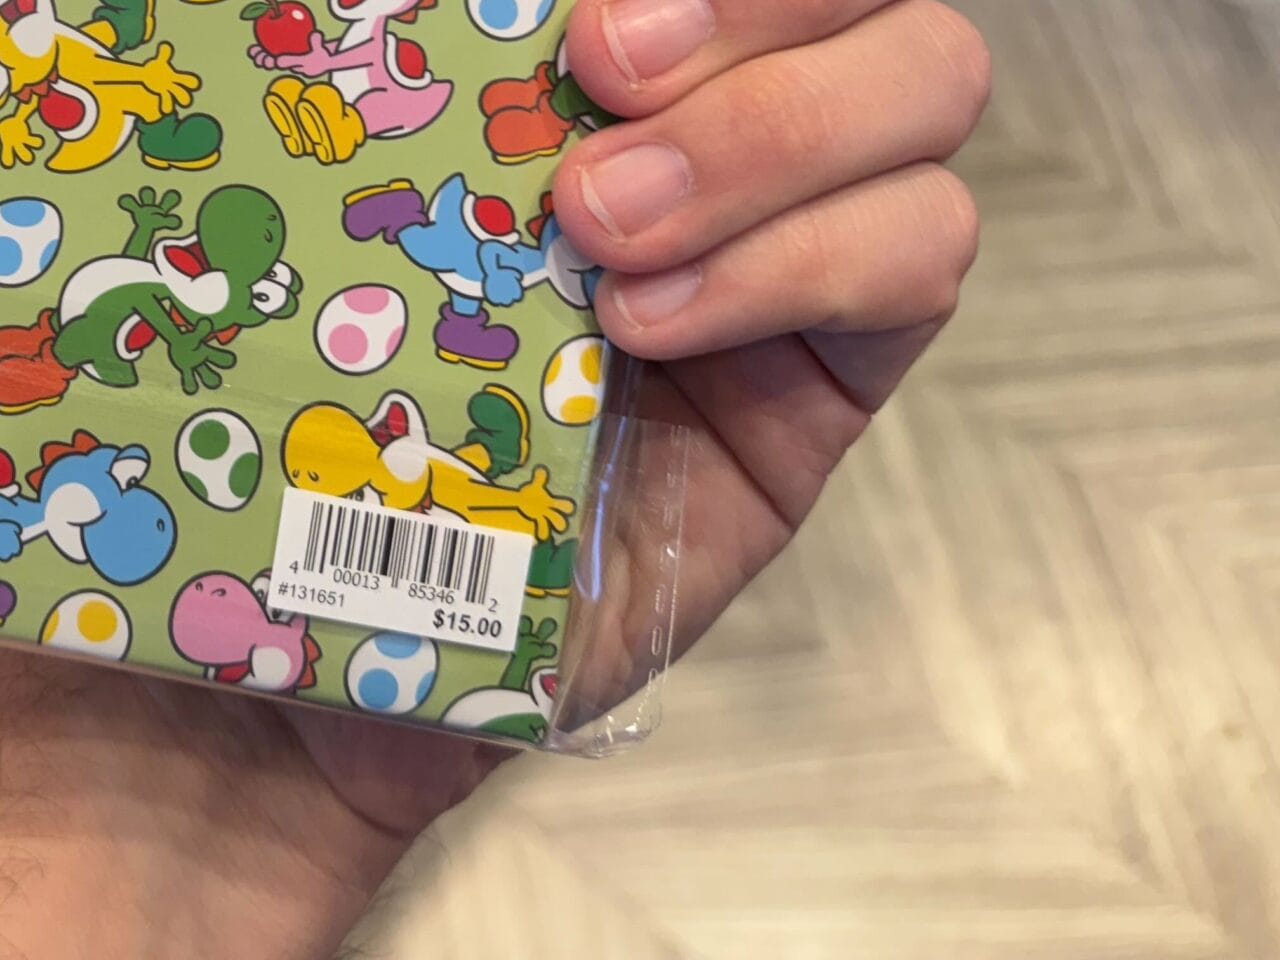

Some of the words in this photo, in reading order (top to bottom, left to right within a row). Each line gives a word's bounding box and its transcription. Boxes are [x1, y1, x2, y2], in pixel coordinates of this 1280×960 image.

[278, 582, 345, 607] #131651
[289, 560, 299, 574] 4
[333, 568, 380, 590] 00013
[407, 583, 455, 605] 85346
[487, 598, 498, 613] 2
[432, 608, 502, 638] $15.00
